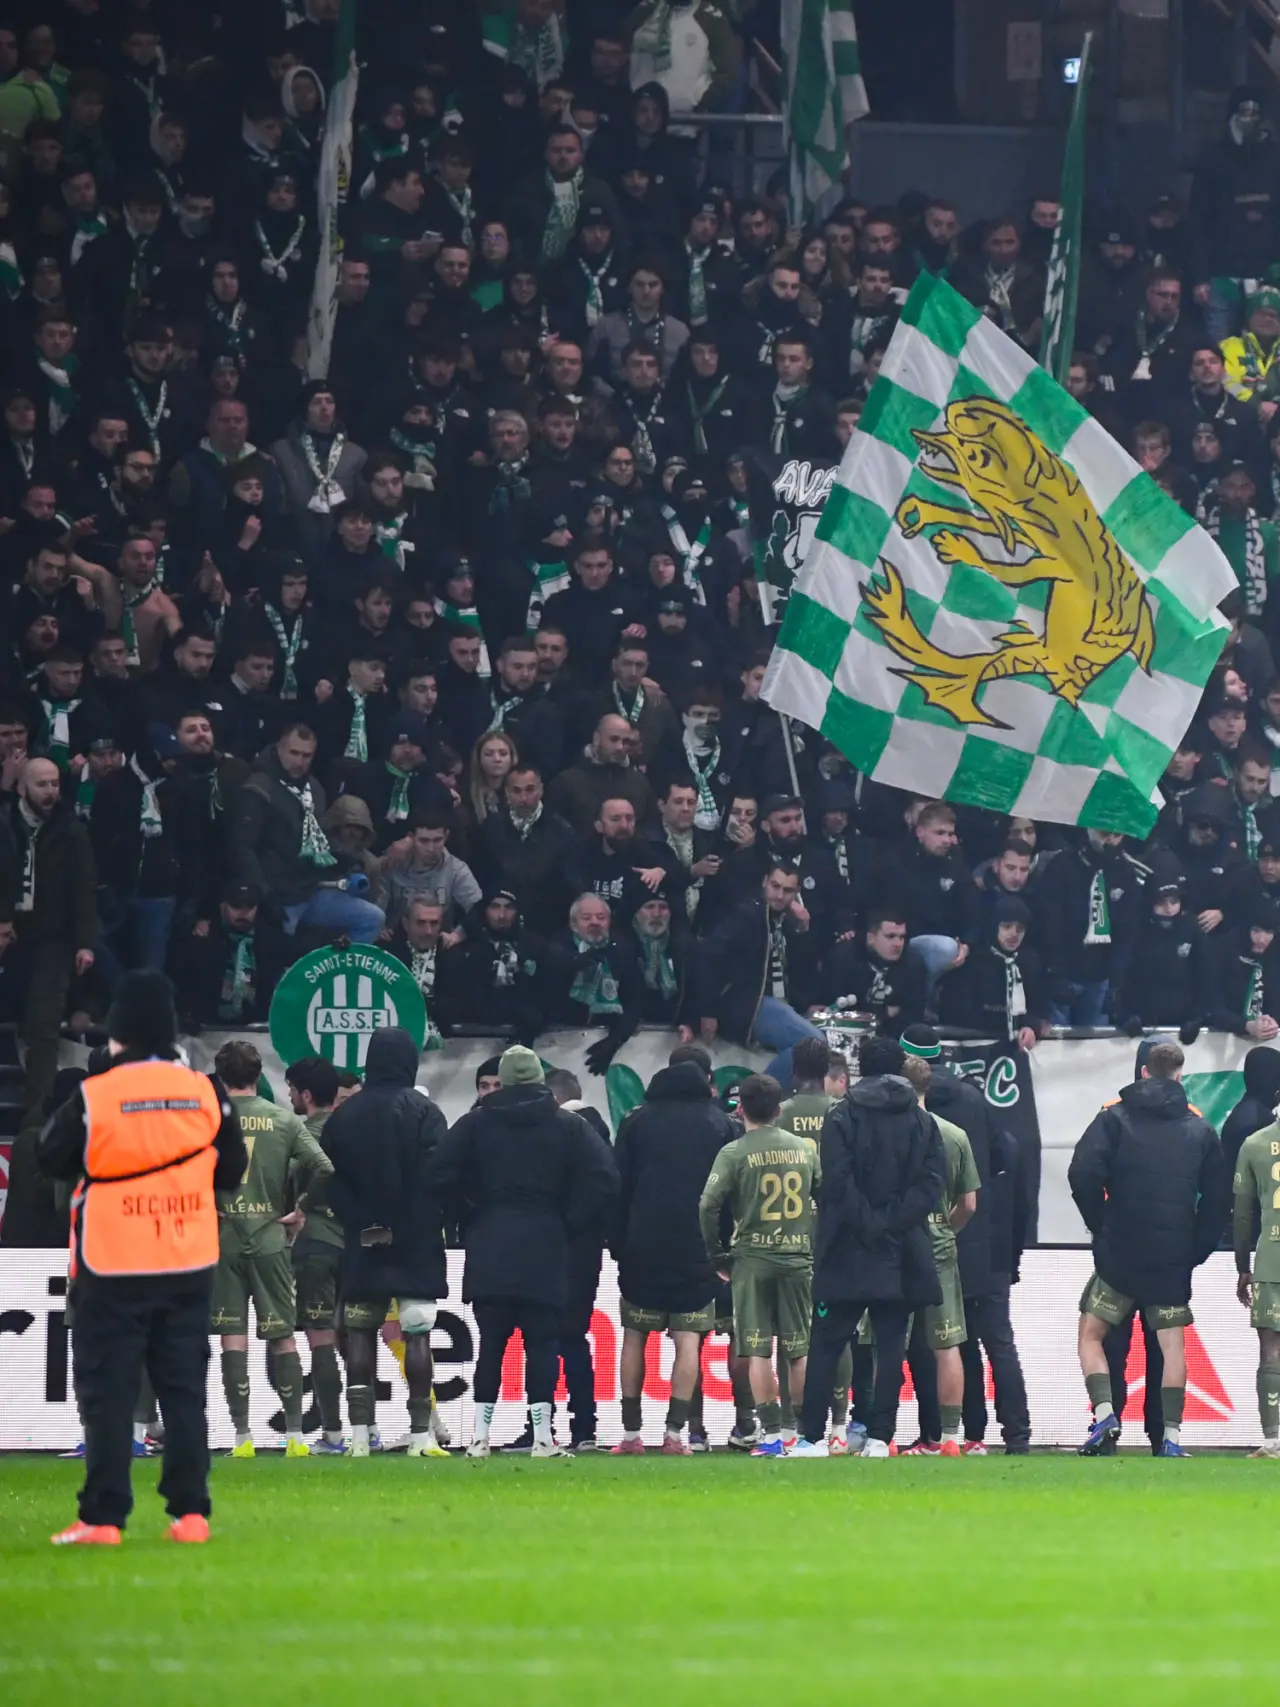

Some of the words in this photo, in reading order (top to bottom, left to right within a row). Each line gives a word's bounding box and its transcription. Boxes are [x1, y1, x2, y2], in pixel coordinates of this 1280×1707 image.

[304, 952, 400, 985] SAINT-ETIENNE
[240, 1116, 274, 1131] DONA
[793, 1116, 824, 1131] EYMA
[760, 1171, 803, 1221] 28
